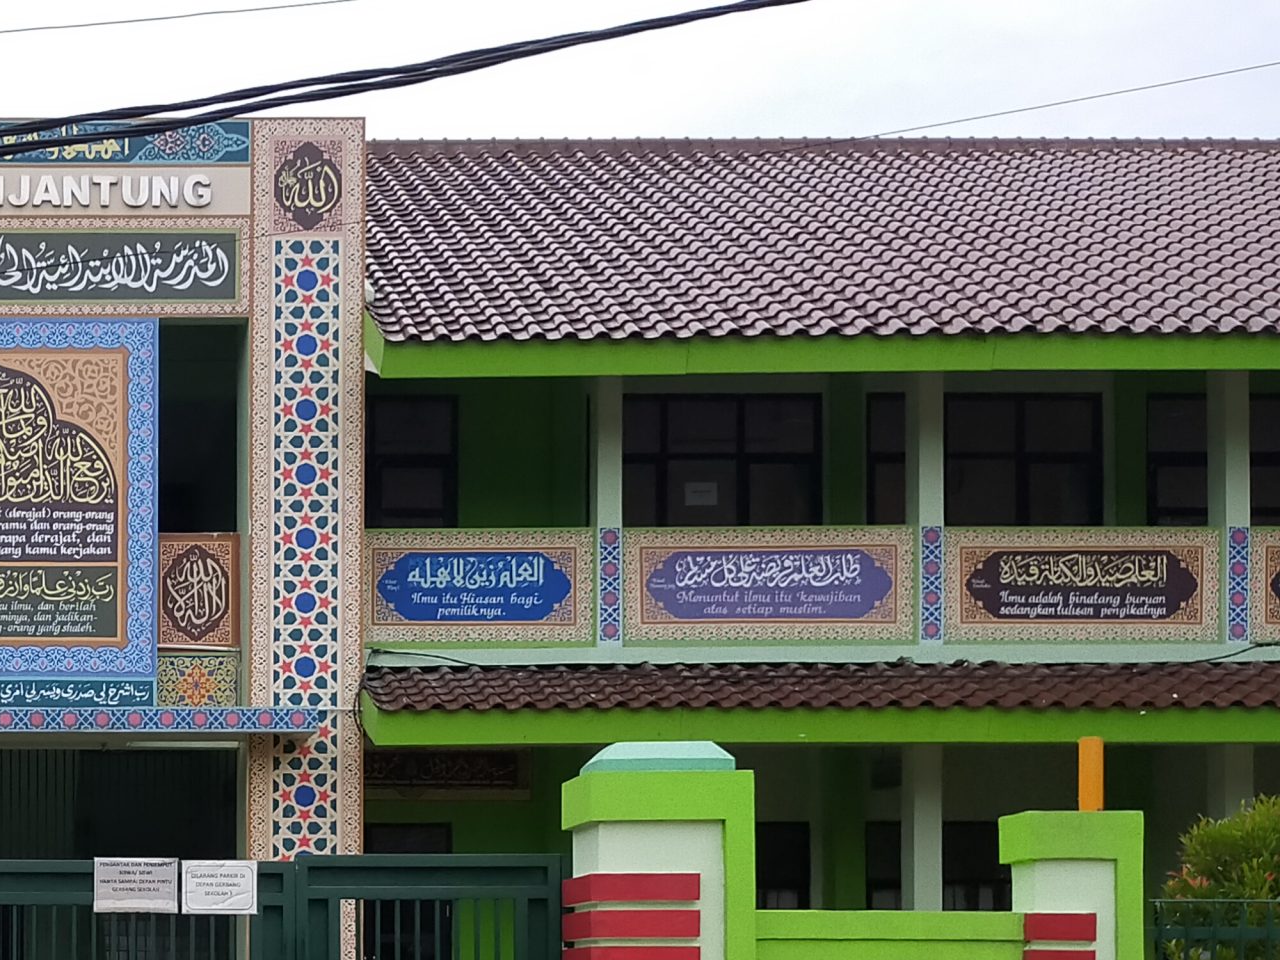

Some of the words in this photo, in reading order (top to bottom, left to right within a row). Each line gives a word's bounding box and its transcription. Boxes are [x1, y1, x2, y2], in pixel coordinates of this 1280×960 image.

[52, 510, 114, 523] orang-orang
[30, 519, 50, 531] dan
[52, 522, 114, 534] orang-orang
[31, 531, 80, 546] derajat,
[87, 531, 112, 543] dan
[25, 543, 57, 555] kamu
[60, 543, 112, 559] kerjakan
[411, 592, 438, 604] Ilmu
[442, 592, 458, 604] itu
[459, 592, 504, 604] Hiasan
[510, 592, 543, 609] bagi
[676, 590, 740, 603] Menuntut
[744, 591, 770, 603] ilmu
[775, 591, 792, 603] itu
[999, 590, 1026, 603] Ilmu
[1028, 590, 1063, 605] adalah
[1069, 591, 1120, 607] binatang
[1124, 592, 1166, 604] buruan
[38, 601, 55, 610] dan
[59, 600, 97, 611] berilah
[436, 604, 506, 619] pemiliknya.
[703, 603, 728, 615] atas
[735, 603, 774, 617] setiap
[779, 603, 826, 615] muslim.
[999, 604, 1055, 618] sedangkan
[1056, 603, 1094, 616] tulisan
[1100, 603, 1167, 618] pengikatnya
[33, 611, 52, 621] dan
[36, 623, 61, 636] yang
[61, 622, 97, 633] shaleh.
